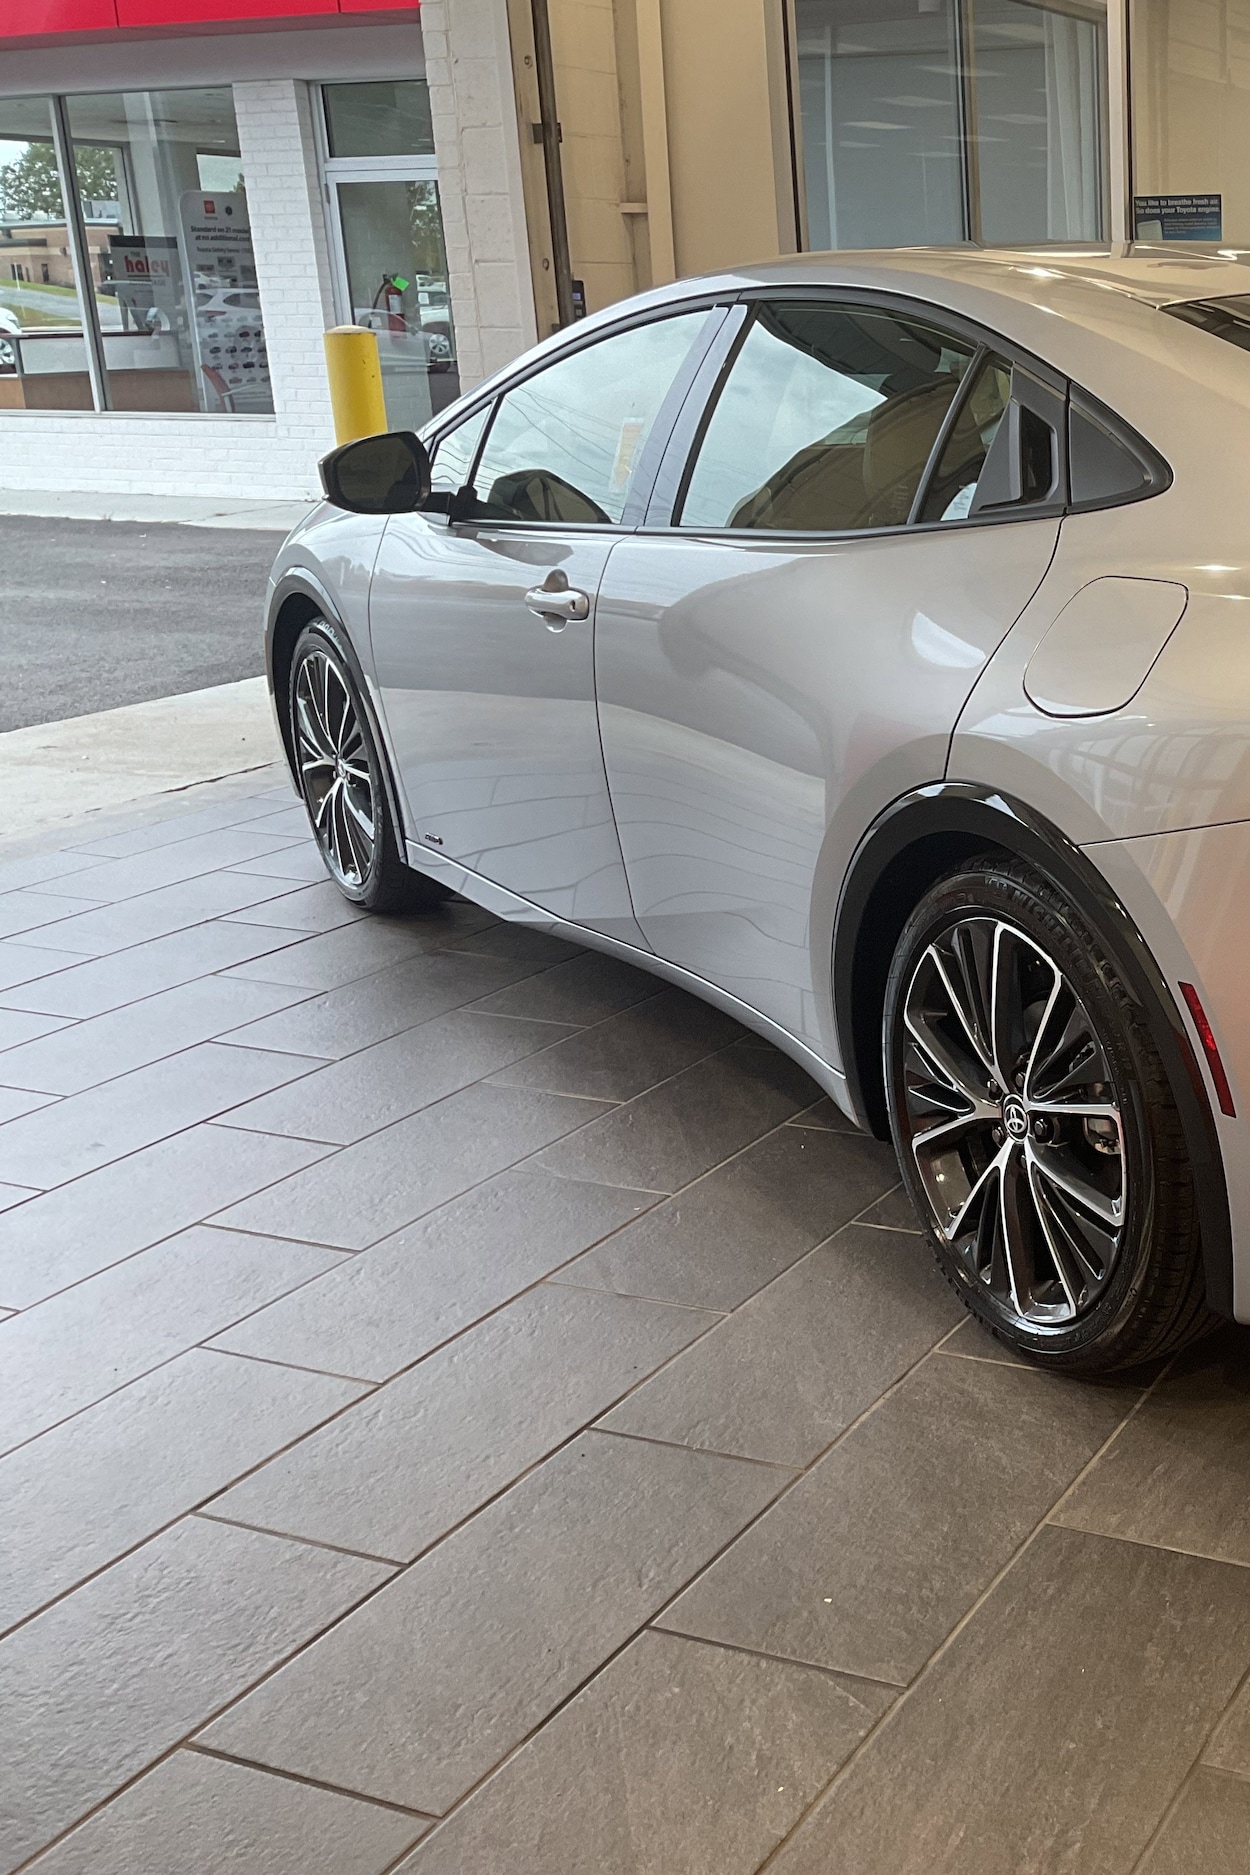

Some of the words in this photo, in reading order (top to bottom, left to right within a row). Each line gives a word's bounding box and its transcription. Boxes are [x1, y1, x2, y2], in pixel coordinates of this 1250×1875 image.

[1176, 206, 1196, 214] Toyota
[190, 225, 217, 233] Standard
[124, 255, 170, 277] haley
